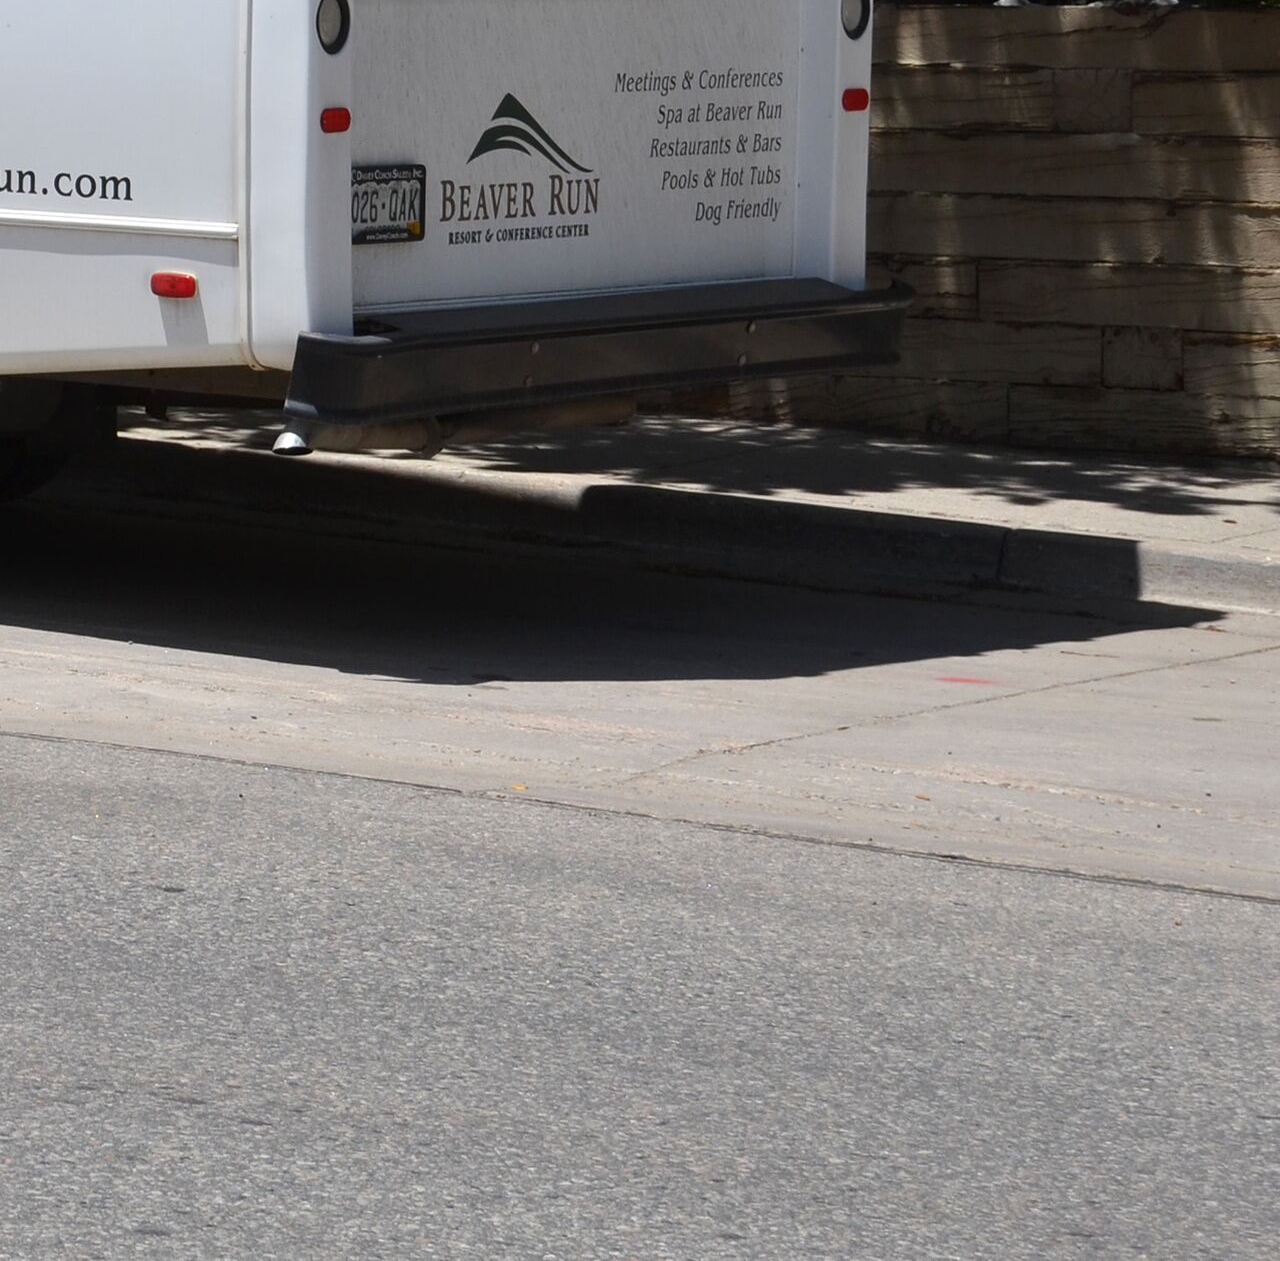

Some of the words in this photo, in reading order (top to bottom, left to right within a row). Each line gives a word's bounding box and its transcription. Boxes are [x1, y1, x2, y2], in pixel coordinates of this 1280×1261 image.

[614, 71, 676, 96] Meetings
[682, 70, 694, 90] &
[699, 68, 783, 89] Conferences
[657, 104, 683, 129] Spa
[688, 103, 700, 122] at
[705, 102, 752, 121] Beaver
[756, 101, 782, 120] Run
[650, 136, 730, 157] Restaurants
[736, 134, 748, 154] &
[753, 134, 782, 152] Bars
[662, 169, 698, 191] Pools
[703, 168, 716, 187] &
[721, 167, 744, 187] Hot
[749, 166, 781, 185] Tubs
[440, 179, 537, 222] BEAVER
[549, 174, 600, 215] RUN
[696, 202, 721, 225] Dog
[727, 197, 781, 222] Friendly
[449, 228, 481, 245] RESORT
[485, 228, 493, 243] &
[496, 225, 553, 242] CONFERENCE
[556, 224, 589, 239] CENTER
